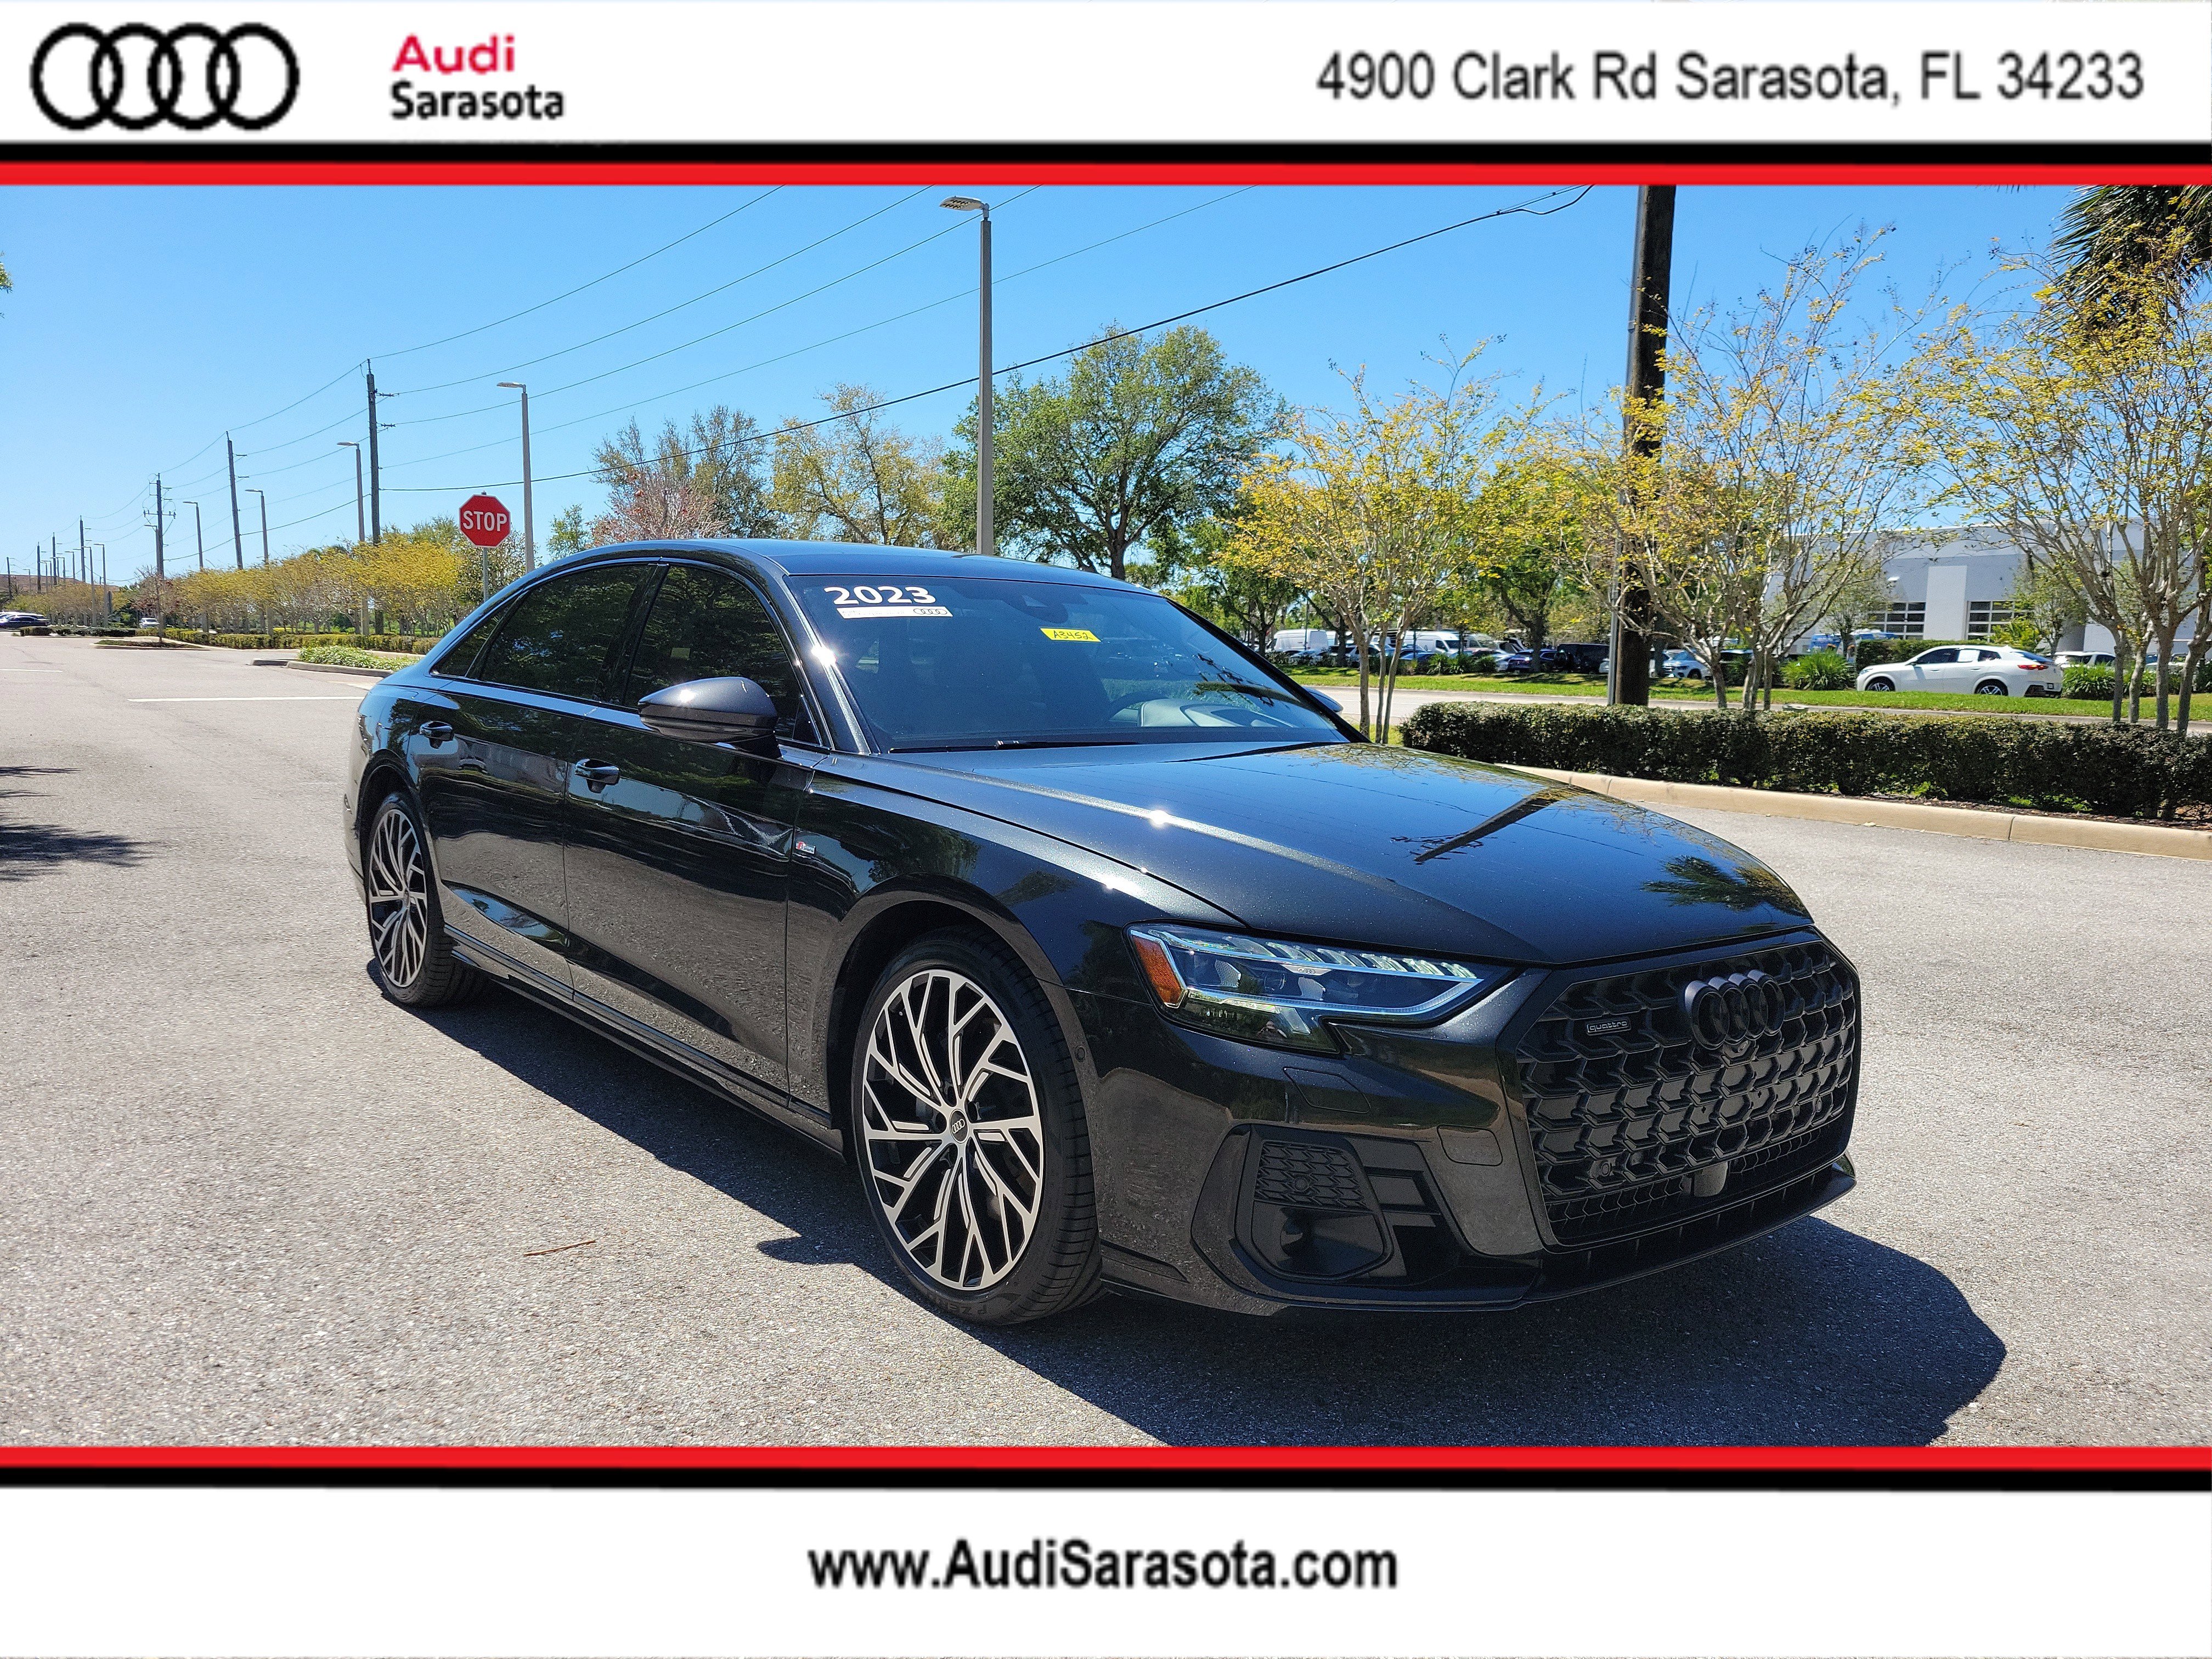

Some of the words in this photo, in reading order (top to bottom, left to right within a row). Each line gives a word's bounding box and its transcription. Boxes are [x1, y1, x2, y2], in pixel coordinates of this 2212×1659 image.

[462, 510, 507, 532] STOP
[823, 585, 936, 605] 2023
[1589, 1021, 1628, 1031] quattro
